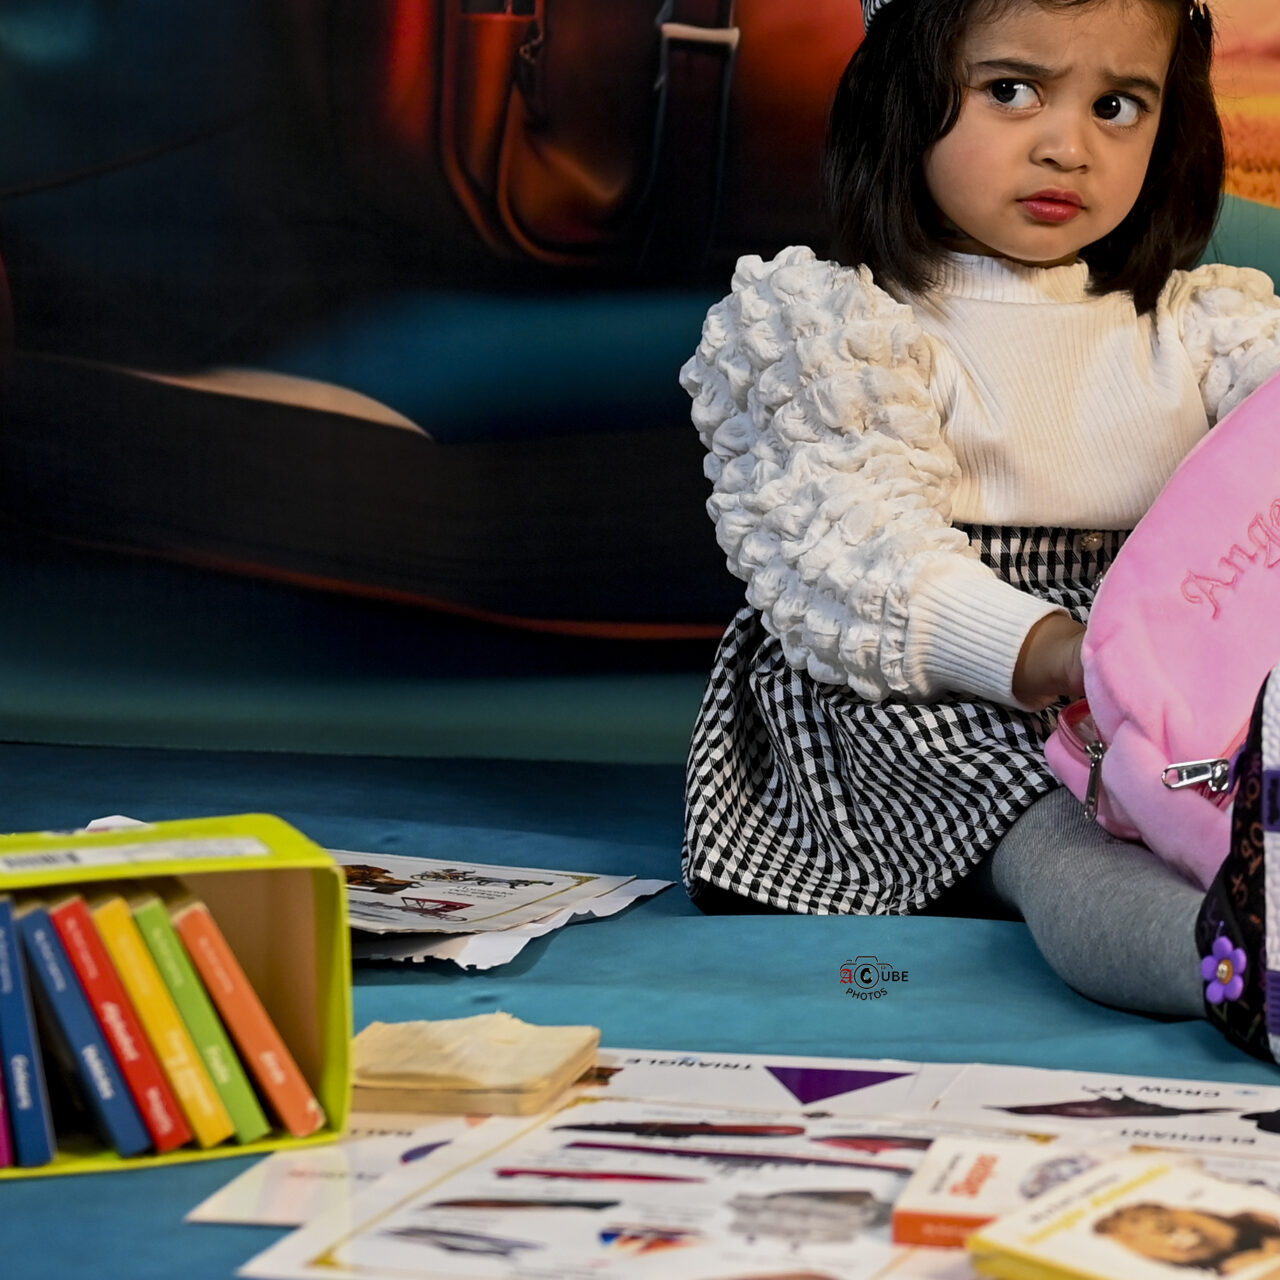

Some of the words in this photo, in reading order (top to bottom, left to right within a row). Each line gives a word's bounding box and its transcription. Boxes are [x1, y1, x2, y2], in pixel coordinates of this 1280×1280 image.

[625, 1057, 752, 1071] TRIANGLE
[1138, 1085, 1221, 1098] CROW
[1120, 1128, 1257, 1145] ELEPHANT
